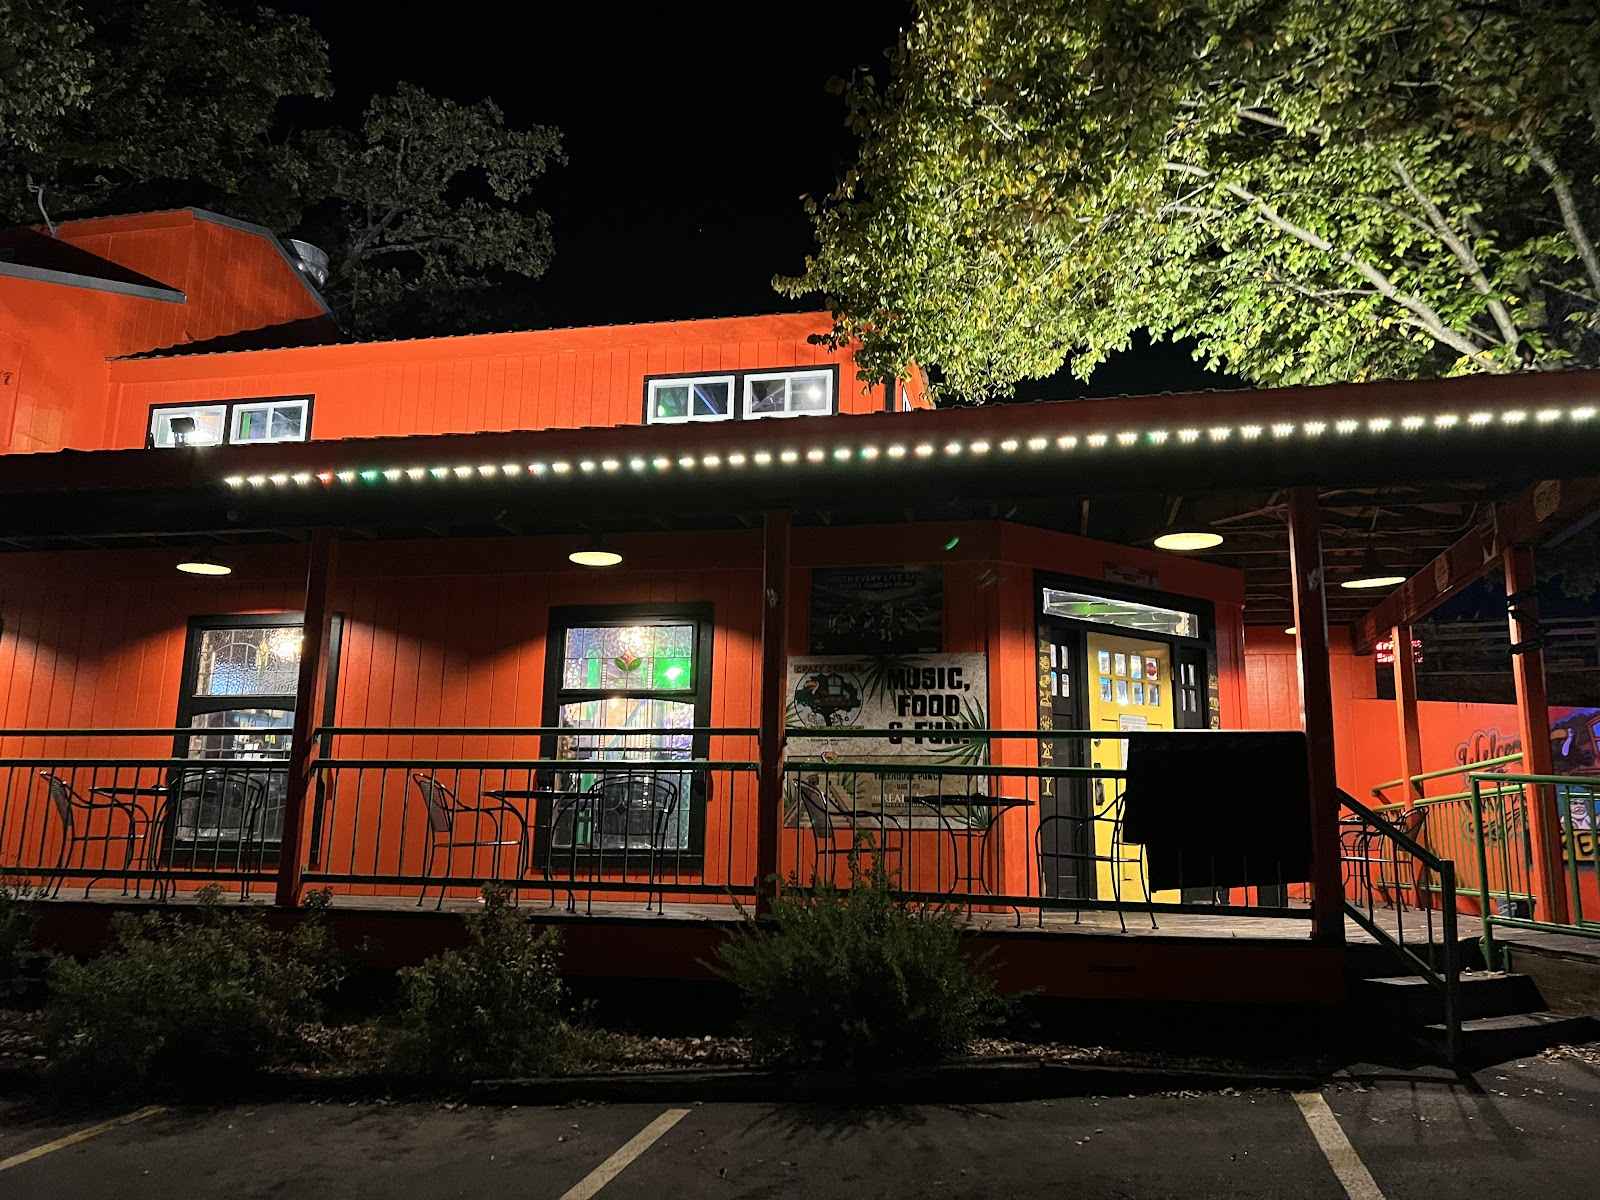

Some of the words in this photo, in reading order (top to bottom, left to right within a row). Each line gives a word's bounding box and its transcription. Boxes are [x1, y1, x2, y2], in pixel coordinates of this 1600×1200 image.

[888, 667, 970, 692] MUSIC,
[898, 694, 960, 716] FOOD
[915, 721, 969, 744] FUN!
